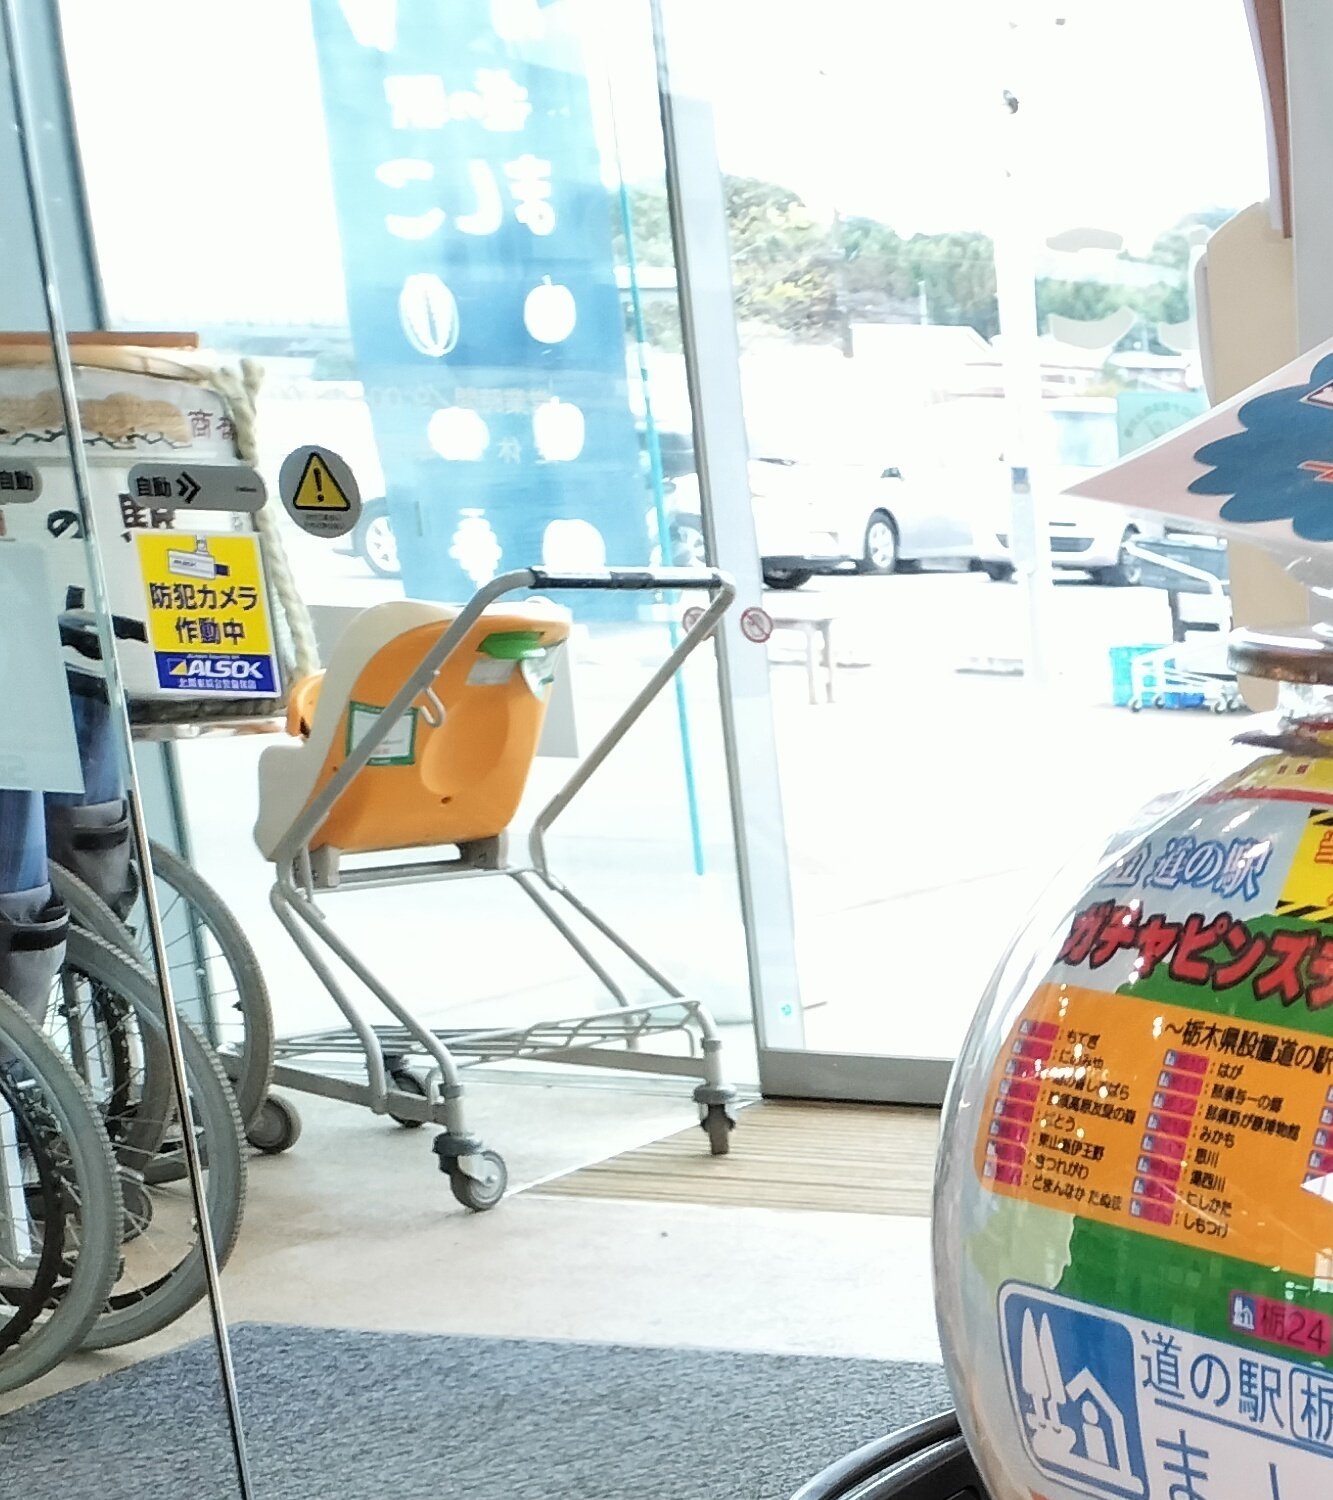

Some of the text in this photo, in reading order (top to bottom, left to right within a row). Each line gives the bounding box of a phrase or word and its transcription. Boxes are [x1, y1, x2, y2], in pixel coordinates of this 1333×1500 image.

[136, 476, 172, 498] 自動
[150, 582, 258, 611] 防犯カメラ
[175, 617, 245, 645] 作動中
[188, 660, 263, 679] ALSOK
[1217, 1063, 1244, 1080] はが
[1200, 1126, 1236, 1148] みかも
[1262, 1306, 1328, 1353] 栃24
[1140, 1328, 1285, 1430] 道の駅
